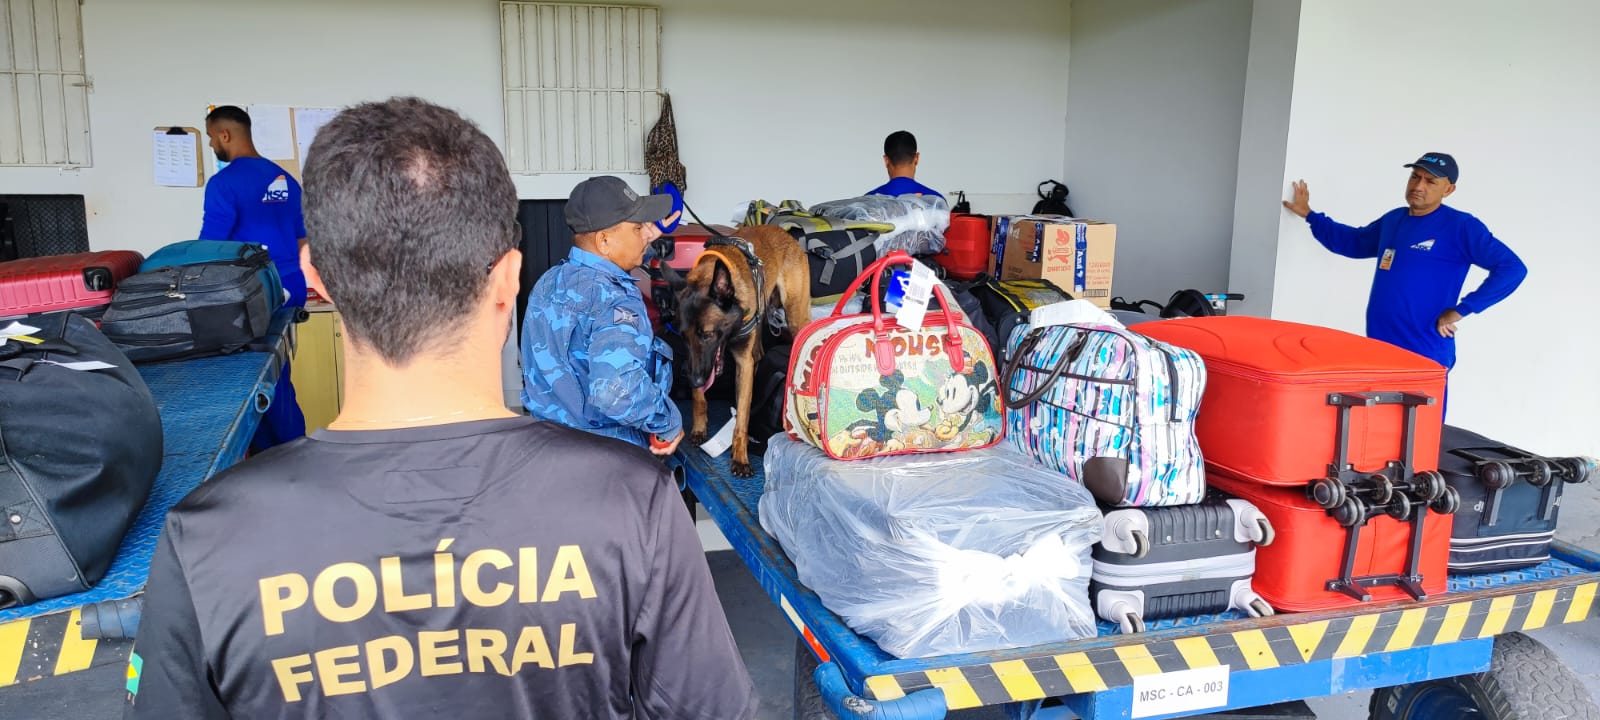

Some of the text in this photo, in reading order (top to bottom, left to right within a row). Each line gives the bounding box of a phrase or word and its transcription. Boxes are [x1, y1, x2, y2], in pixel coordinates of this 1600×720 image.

[259, 538, 597, 636] POLÍCIA
[271, 623, 595, 702] FEDERAL
[1140, 688, 1166, 702] MSC
[1177, 685, 1193, 697] CA
[1203, 680, 1223, 694] 003
